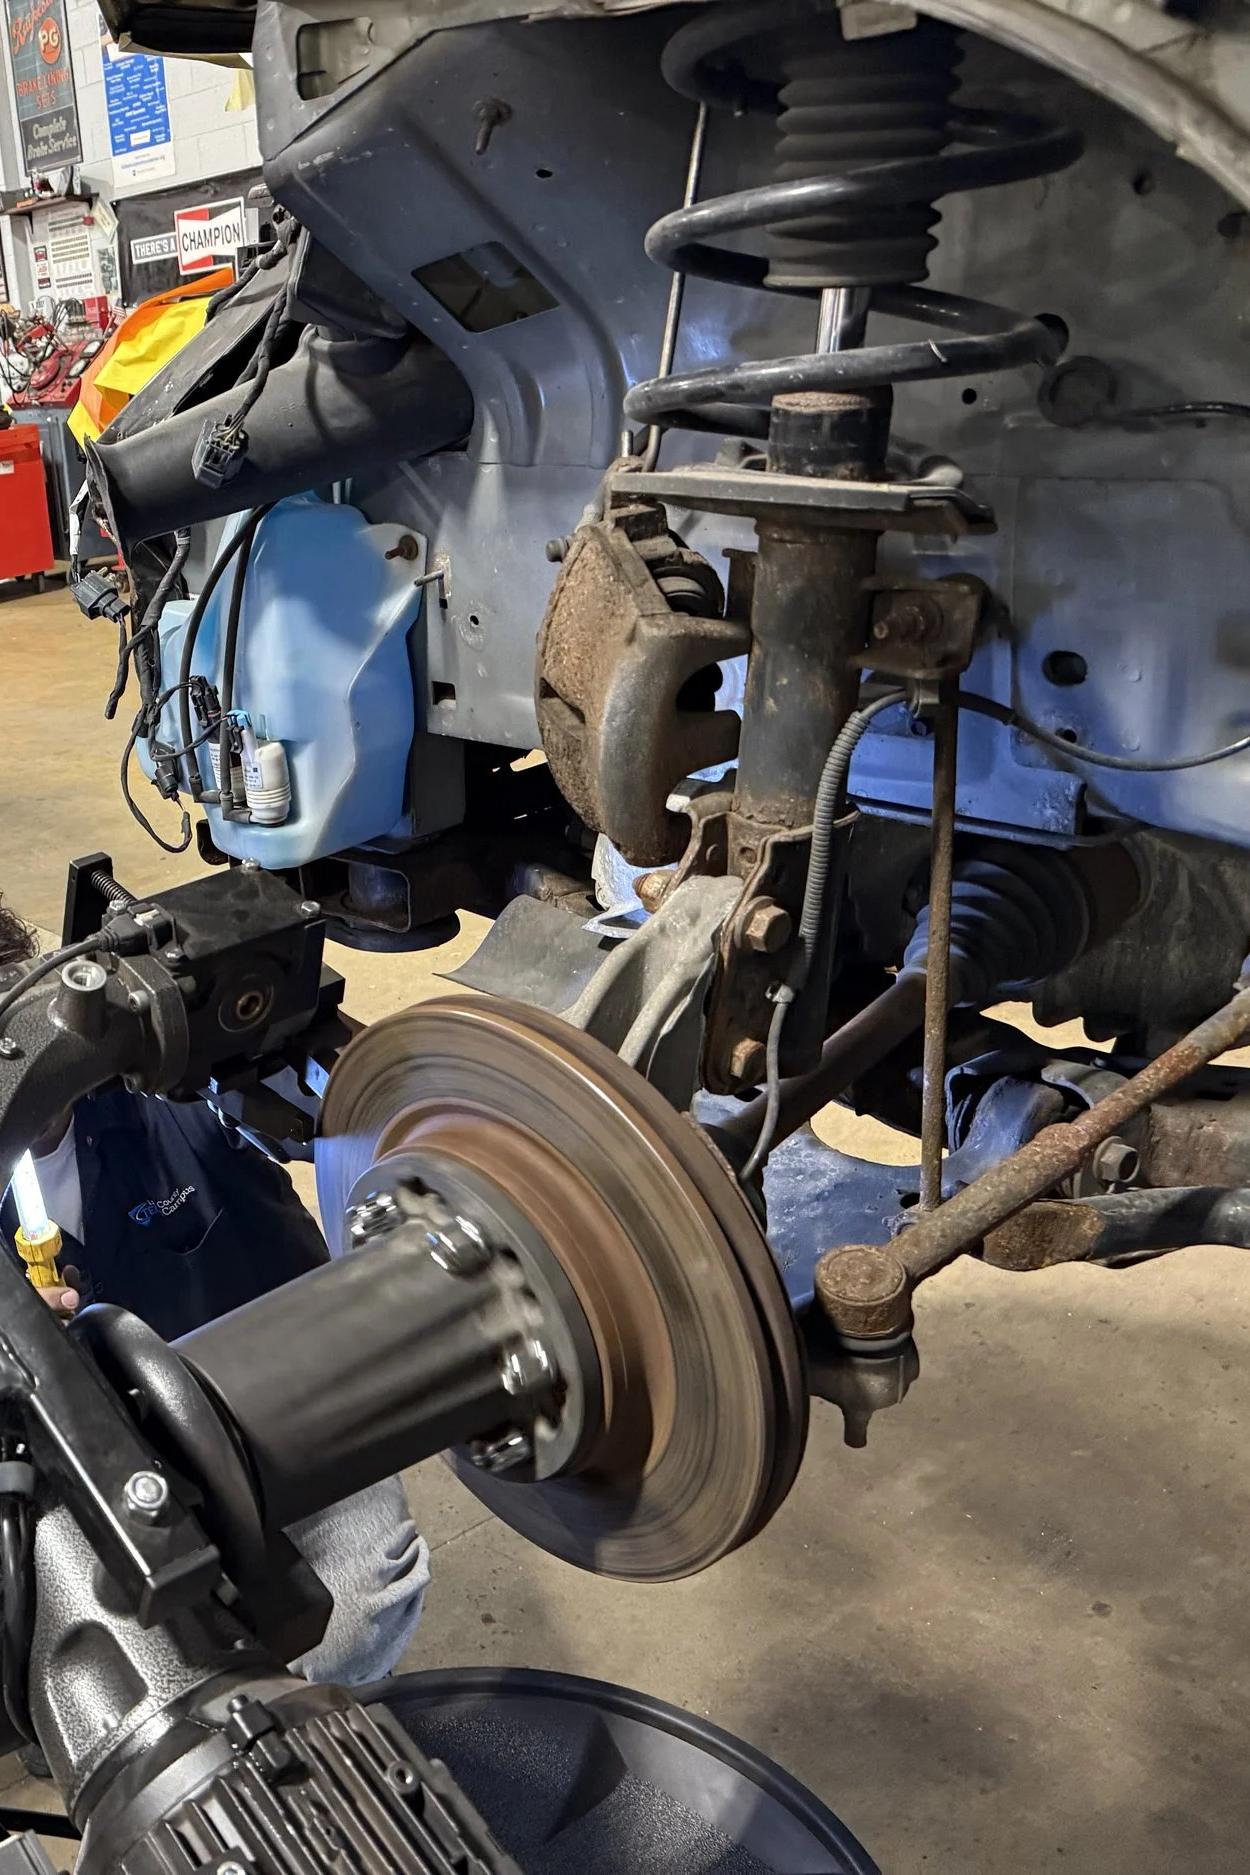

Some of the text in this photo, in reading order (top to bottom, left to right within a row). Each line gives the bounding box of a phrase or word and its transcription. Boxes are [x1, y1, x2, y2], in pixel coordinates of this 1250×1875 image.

[38, 27, 59, 52] PG
[16, 67, 69, 97] BRAKE LINING
[48, 133, 77, 154] Service
[134, 222, 240, 258] THERE'S A CHAMPION
